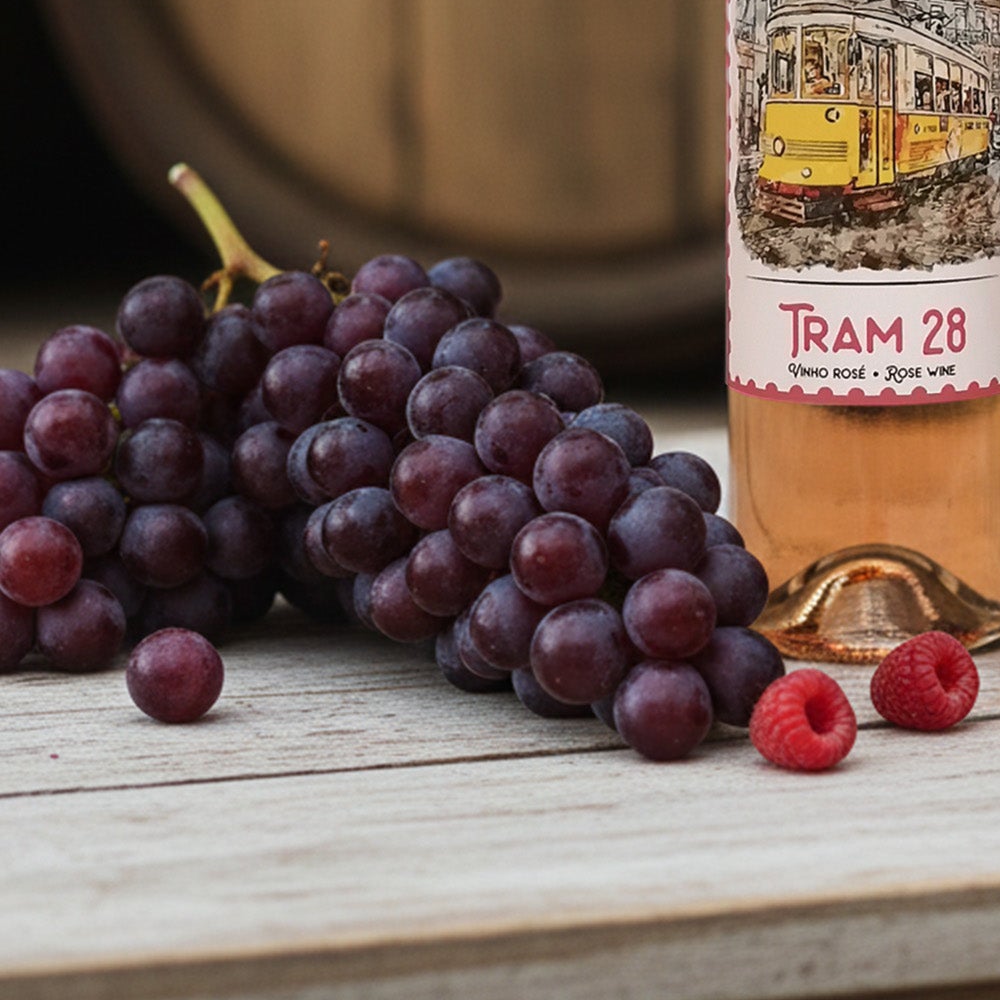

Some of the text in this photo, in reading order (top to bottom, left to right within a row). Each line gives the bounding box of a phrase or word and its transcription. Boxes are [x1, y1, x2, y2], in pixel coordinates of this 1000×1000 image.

[778, 302, 967, 359] TRAM 28
[787, 362, 956, 384] VINHO ROSÉ ROSE WINE
